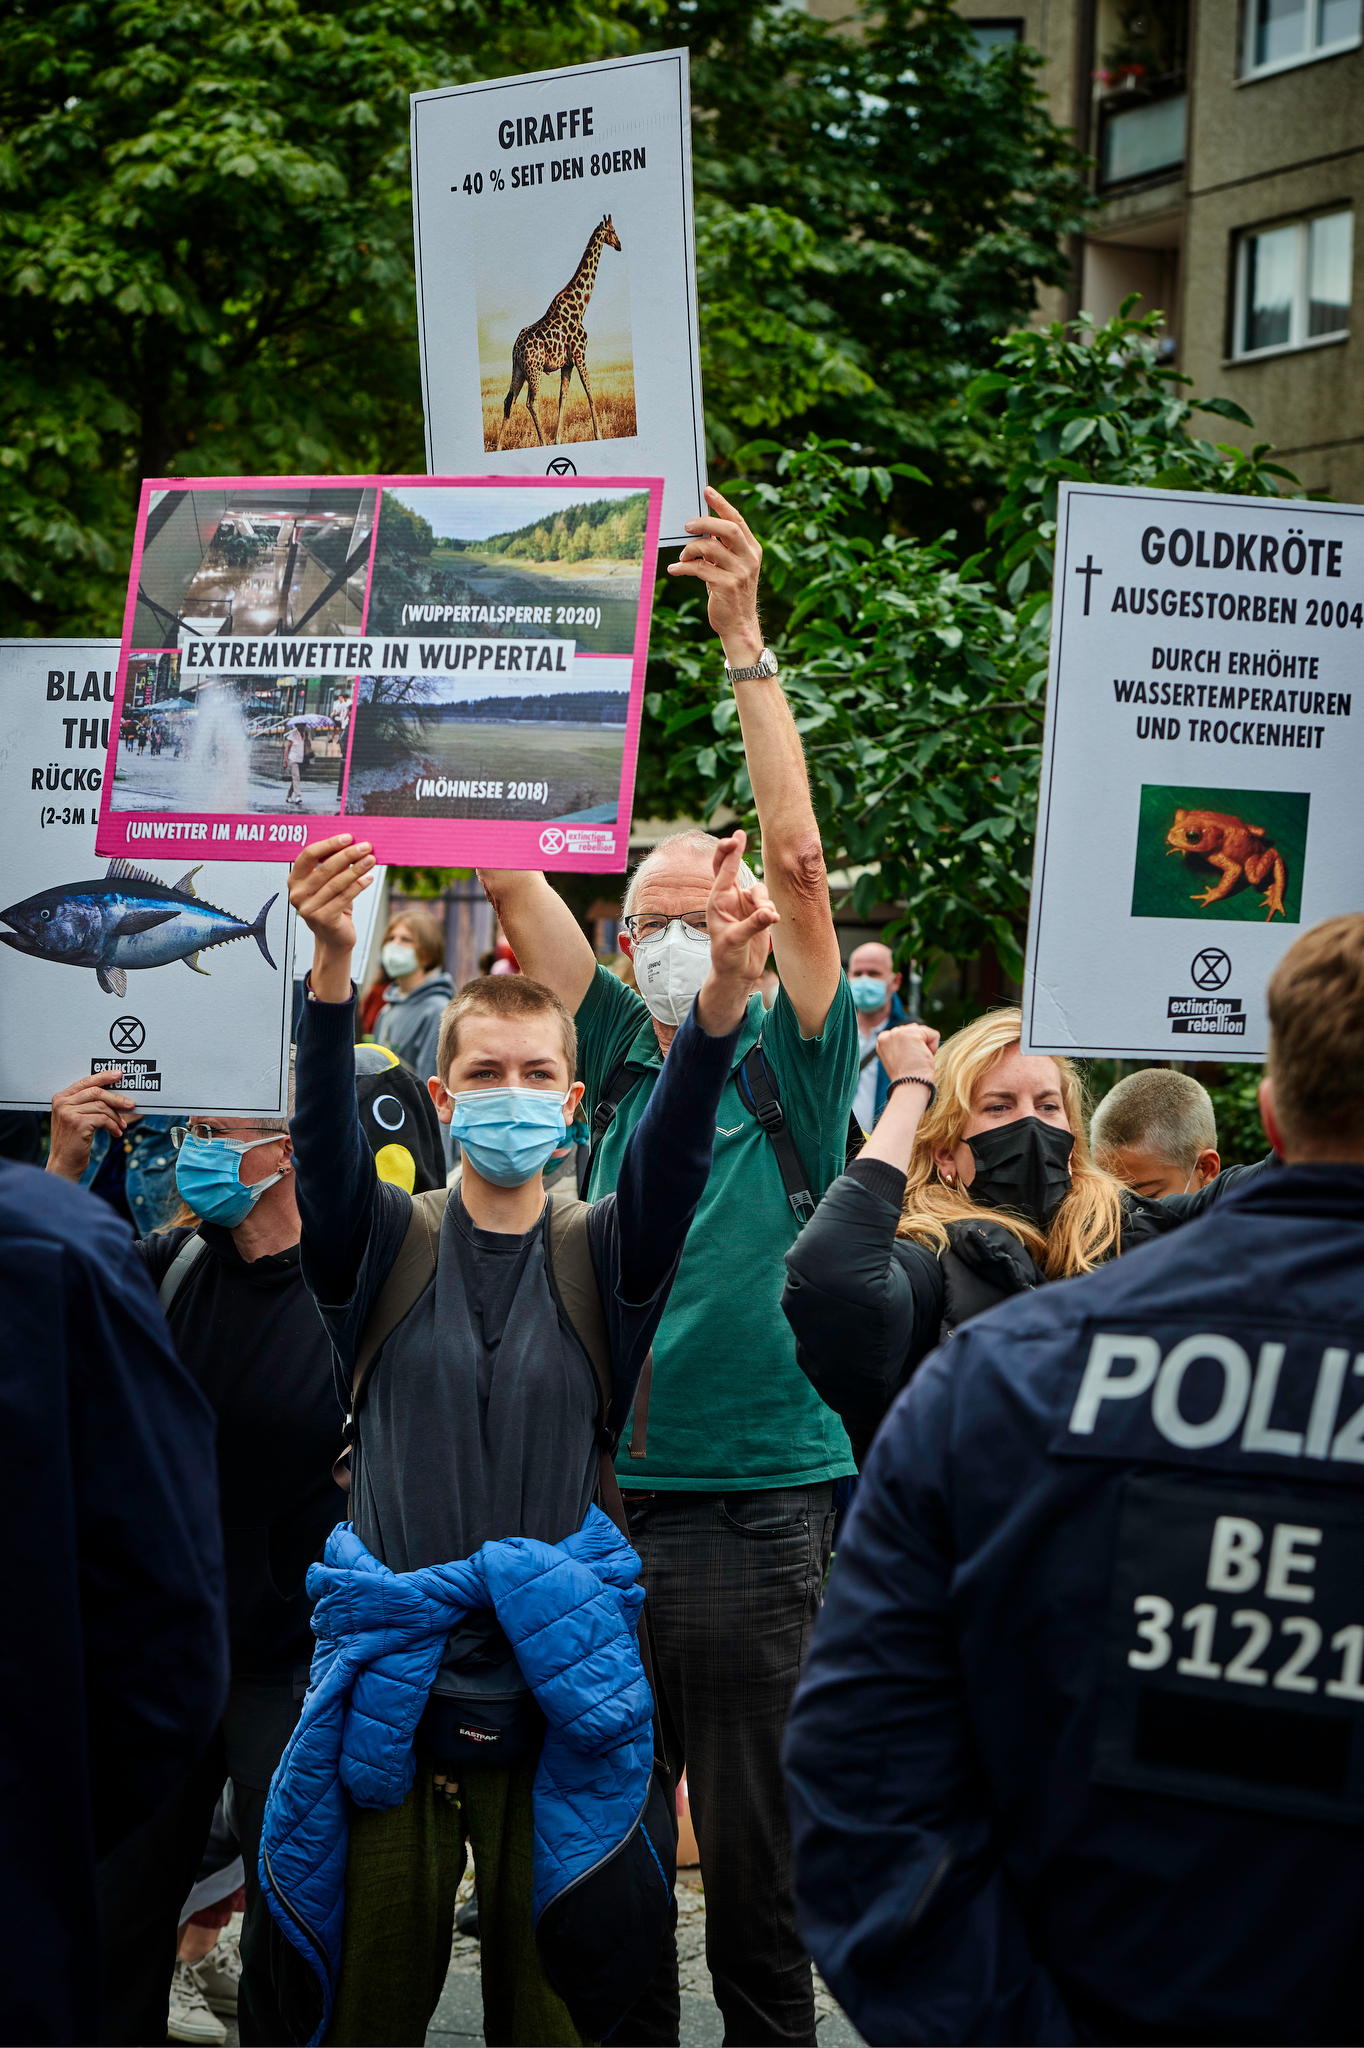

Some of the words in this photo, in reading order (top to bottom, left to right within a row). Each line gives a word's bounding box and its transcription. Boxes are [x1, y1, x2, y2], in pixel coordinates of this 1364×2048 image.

[498, 106, 594, 150] GIRAFFE
[462, 172, 484, 195] 40
[489, 168, 505, 192] %
[511, 162, 545, 189] SEIT
[550, 156, 584, 182] DEN
[590, 146, 646, 177] 80ERN
[1141, 525, 1343, 578] GOLDKRÖTE
[401, 604, 552, 626] (WUPPERTALSPERRE
[555, 606, 601, 630] 2020)
[1111, 586, 1297, 625] AUSGESTORBEN
[1305, 598, 1364, 629] 2004
[186, 641, 373, 669] EXTREMWETTER
[381, 643, 409, 669] IN
[419, 644, 566, 672] WUPPERTAL
[1151, 646, 1221, 674] DURCH
[1228, 649, 1319, 680] ERHÖHTE
[46, 670, 118, 702] BLAU
[1113, 679, 1352, 717] WASSERTEMPERATUREN
[1136, 716, 1181, 740] UND
[1188, 719, 1325, 749] TROCKENHEIT
[31, 762, 103, 791] RÜCKG
[415, 776, 504, 801] (MÖHNESEE
[506, 781, 549, 805] 2018)
[40, 806, 85, 829] (2-3M
[126, 821, 208, 843] (UNWETTER
[211, 823, 230, 841] IM
[235, 824, 265, 841] MAI
[268, 824, 308, 847] 2018)
[568, 830, 606, 841] extinction
[578, 840, 613, 852] rebellion
[1170, 998, 1232, 1014] extinction
[1187, 1014, 1243, 1033] rebellion
[94, 1060, 147, 1073] extinction
[1206, 1515, 1323, 1603] BE
[1127, 1594, 1364, 1701] 31221
[459, 1729, 498, 1741] EASTPAK
